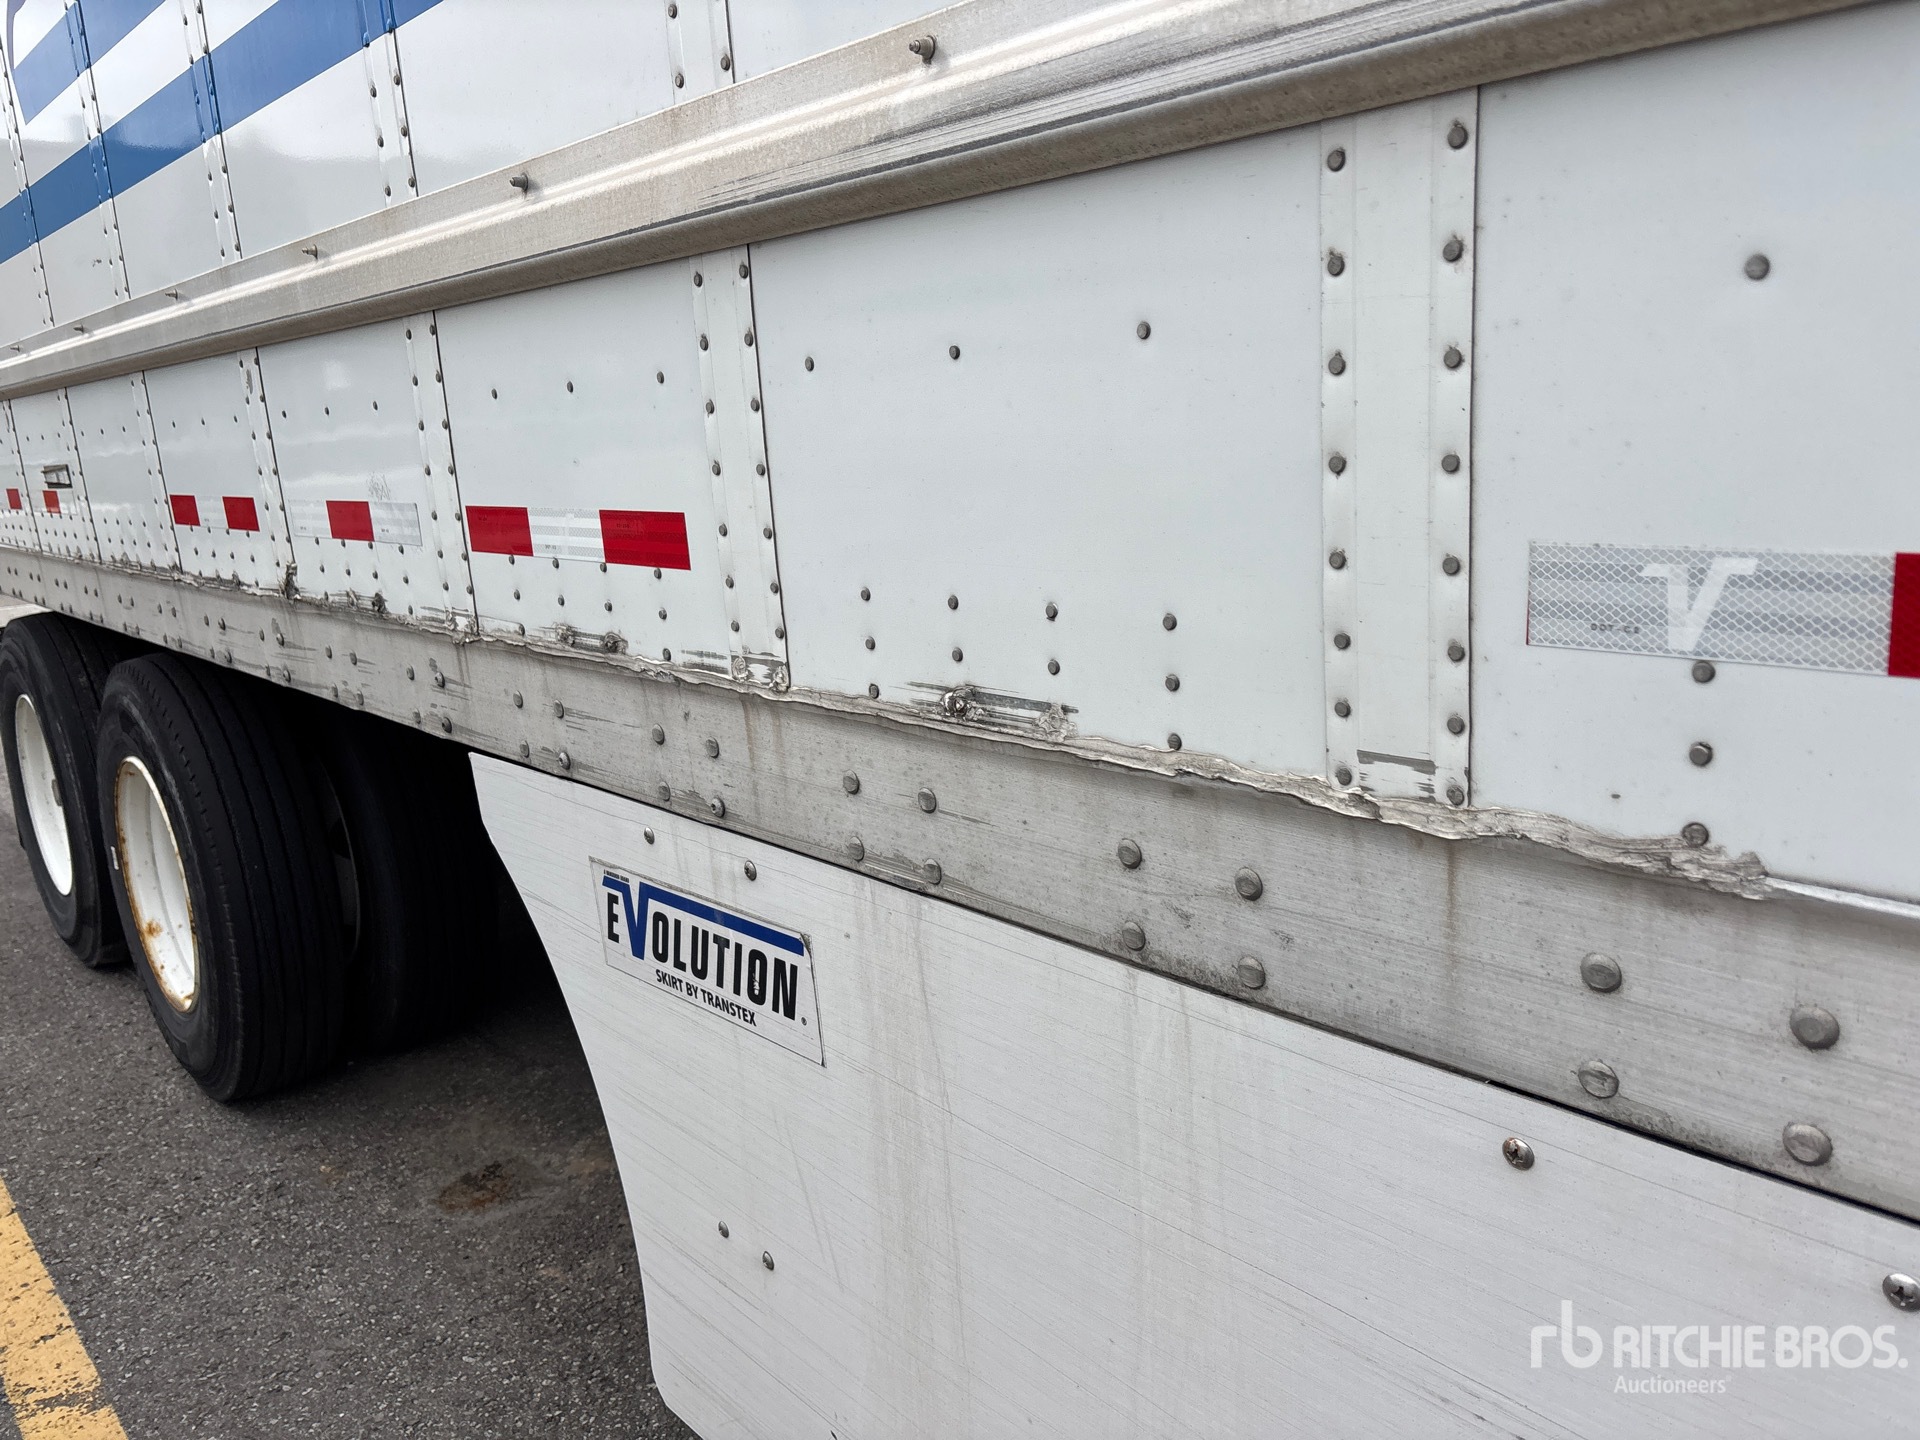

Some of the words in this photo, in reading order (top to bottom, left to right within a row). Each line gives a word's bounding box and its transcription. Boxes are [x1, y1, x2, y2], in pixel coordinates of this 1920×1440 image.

[1590, 623, 1640, 634] DOT-C2
[602, 875, 804, 1021] EVOLUTION
[655, 968, 684, 992] SKIRT
[686, 982, 698, 1000] BY
[700, 989, 757, 1027] TRANSTEX
